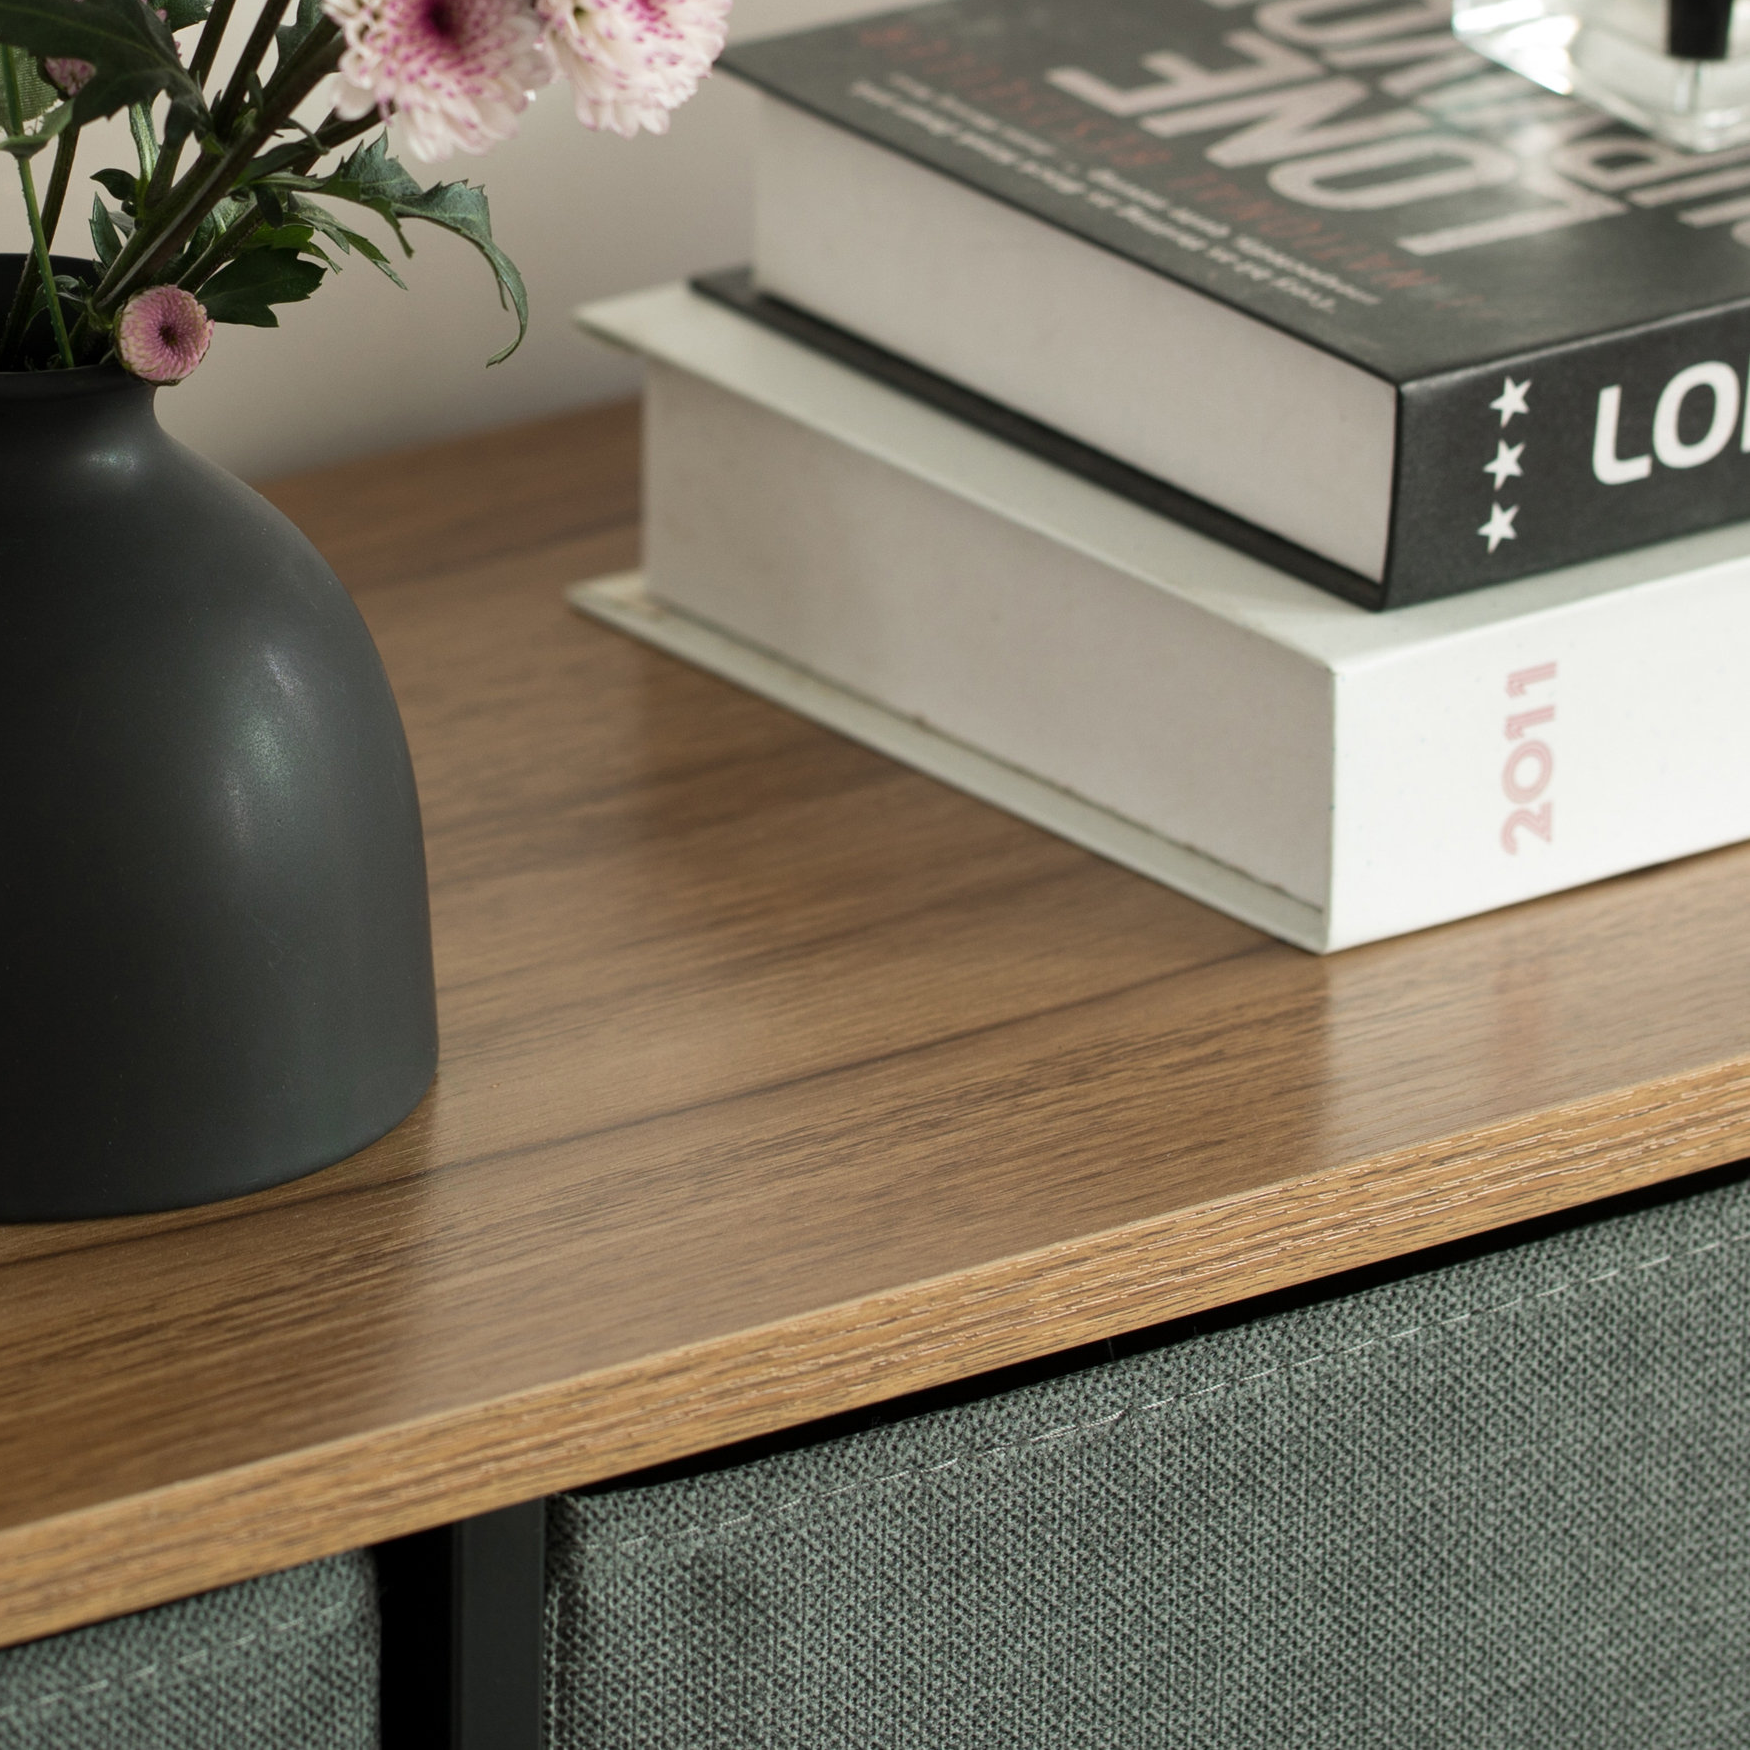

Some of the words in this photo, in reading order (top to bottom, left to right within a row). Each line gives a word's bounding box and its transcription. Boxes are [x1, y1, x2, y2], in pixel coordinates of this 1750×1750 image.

[1045, 26, 1630, 256] LONE
[1592, 350, 1750, 485] LO
[1500, 661, 1558, 855] 2011
